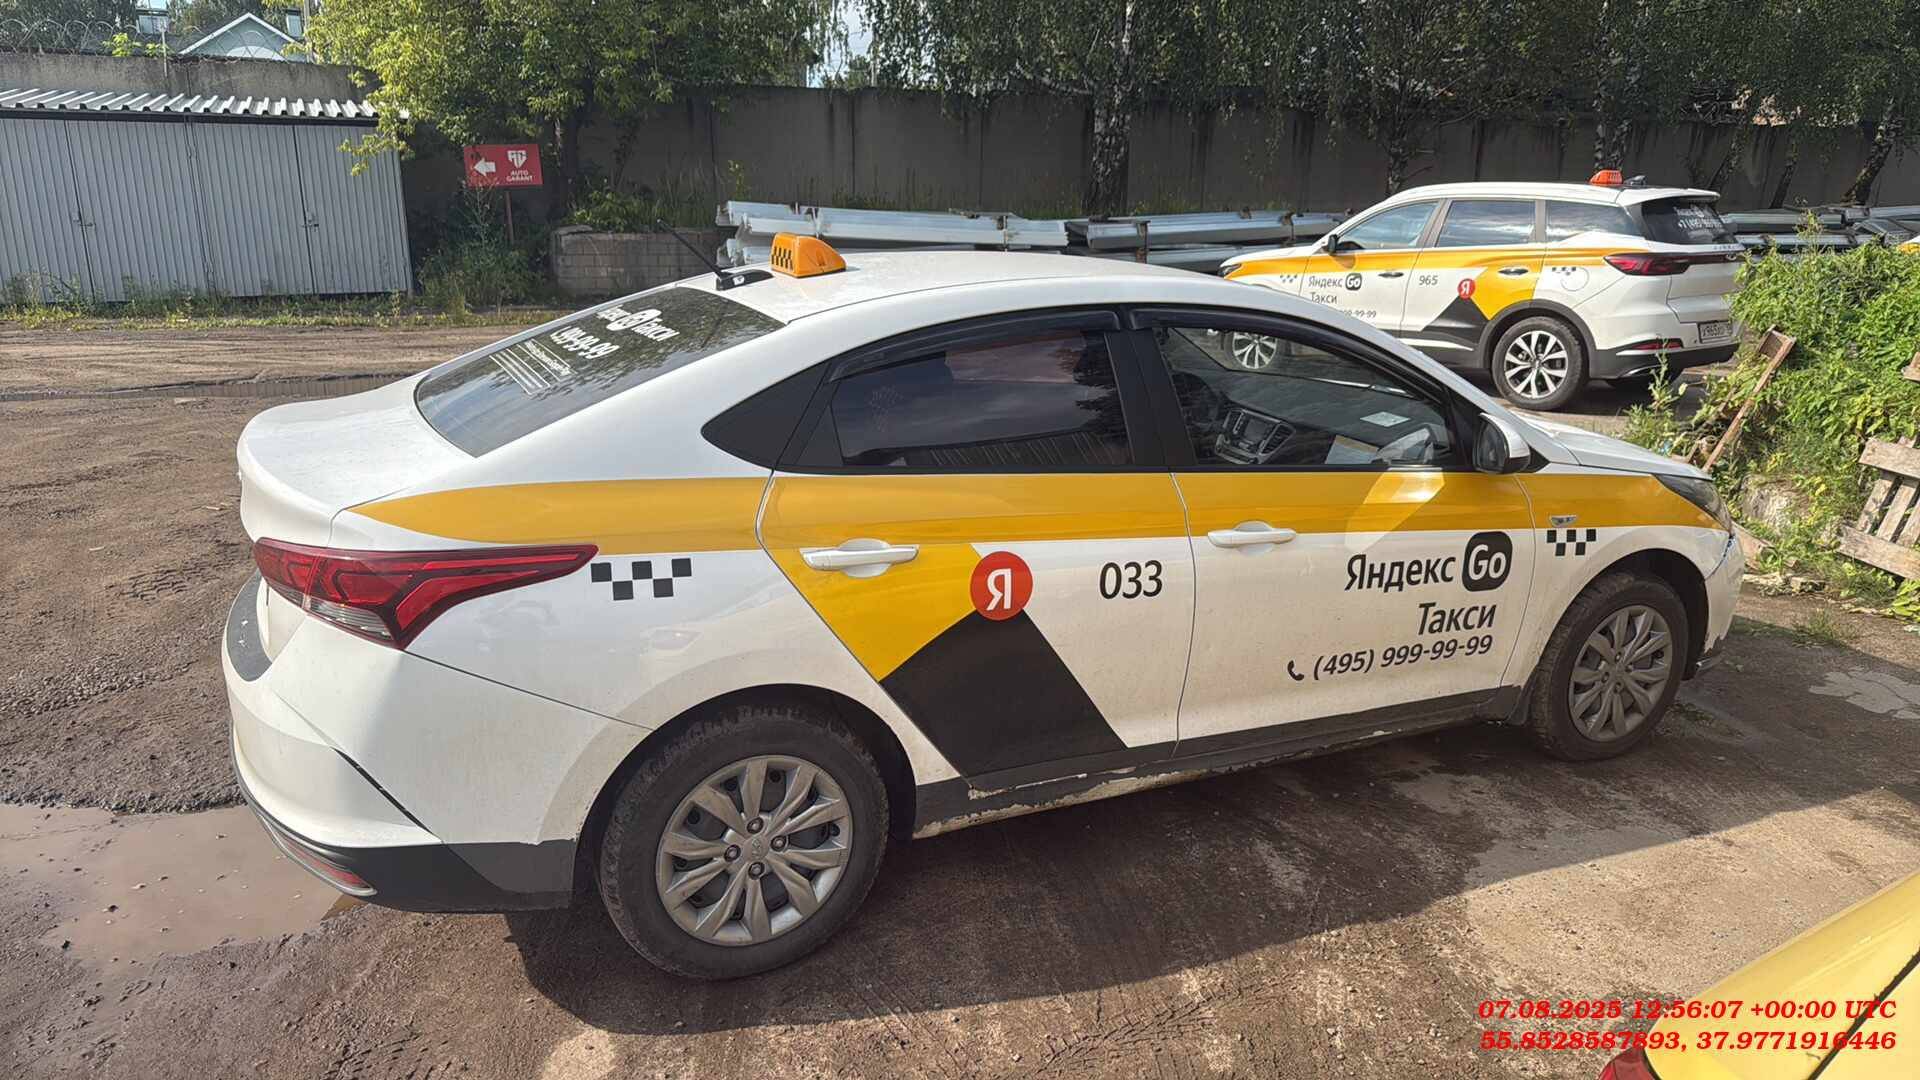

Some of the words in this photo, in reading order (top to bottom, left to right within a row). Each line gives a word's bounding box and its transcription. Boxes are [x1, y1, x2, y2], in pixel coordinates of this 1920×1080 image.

[1308, 276, 1343, 289] Яндекс
[1345, 274, 1361, 289] Go
[1418, 275, 1438, 286] 965
[1460, 281, 1470, 296] Я
[1310, 291, 1337, 304] Такси
[1099, 560, 1163, 599] 033
[1344, 553, 1456, 592] Яндекс
[1466, 542, 1508, 582] Go
[985, 567, 1012, 611] Я
[1417, 602, 1497, 635] Такси
[1313, 649, 1375, 680] (495)
[1380, 635, 1493, 667] 999-99-99
